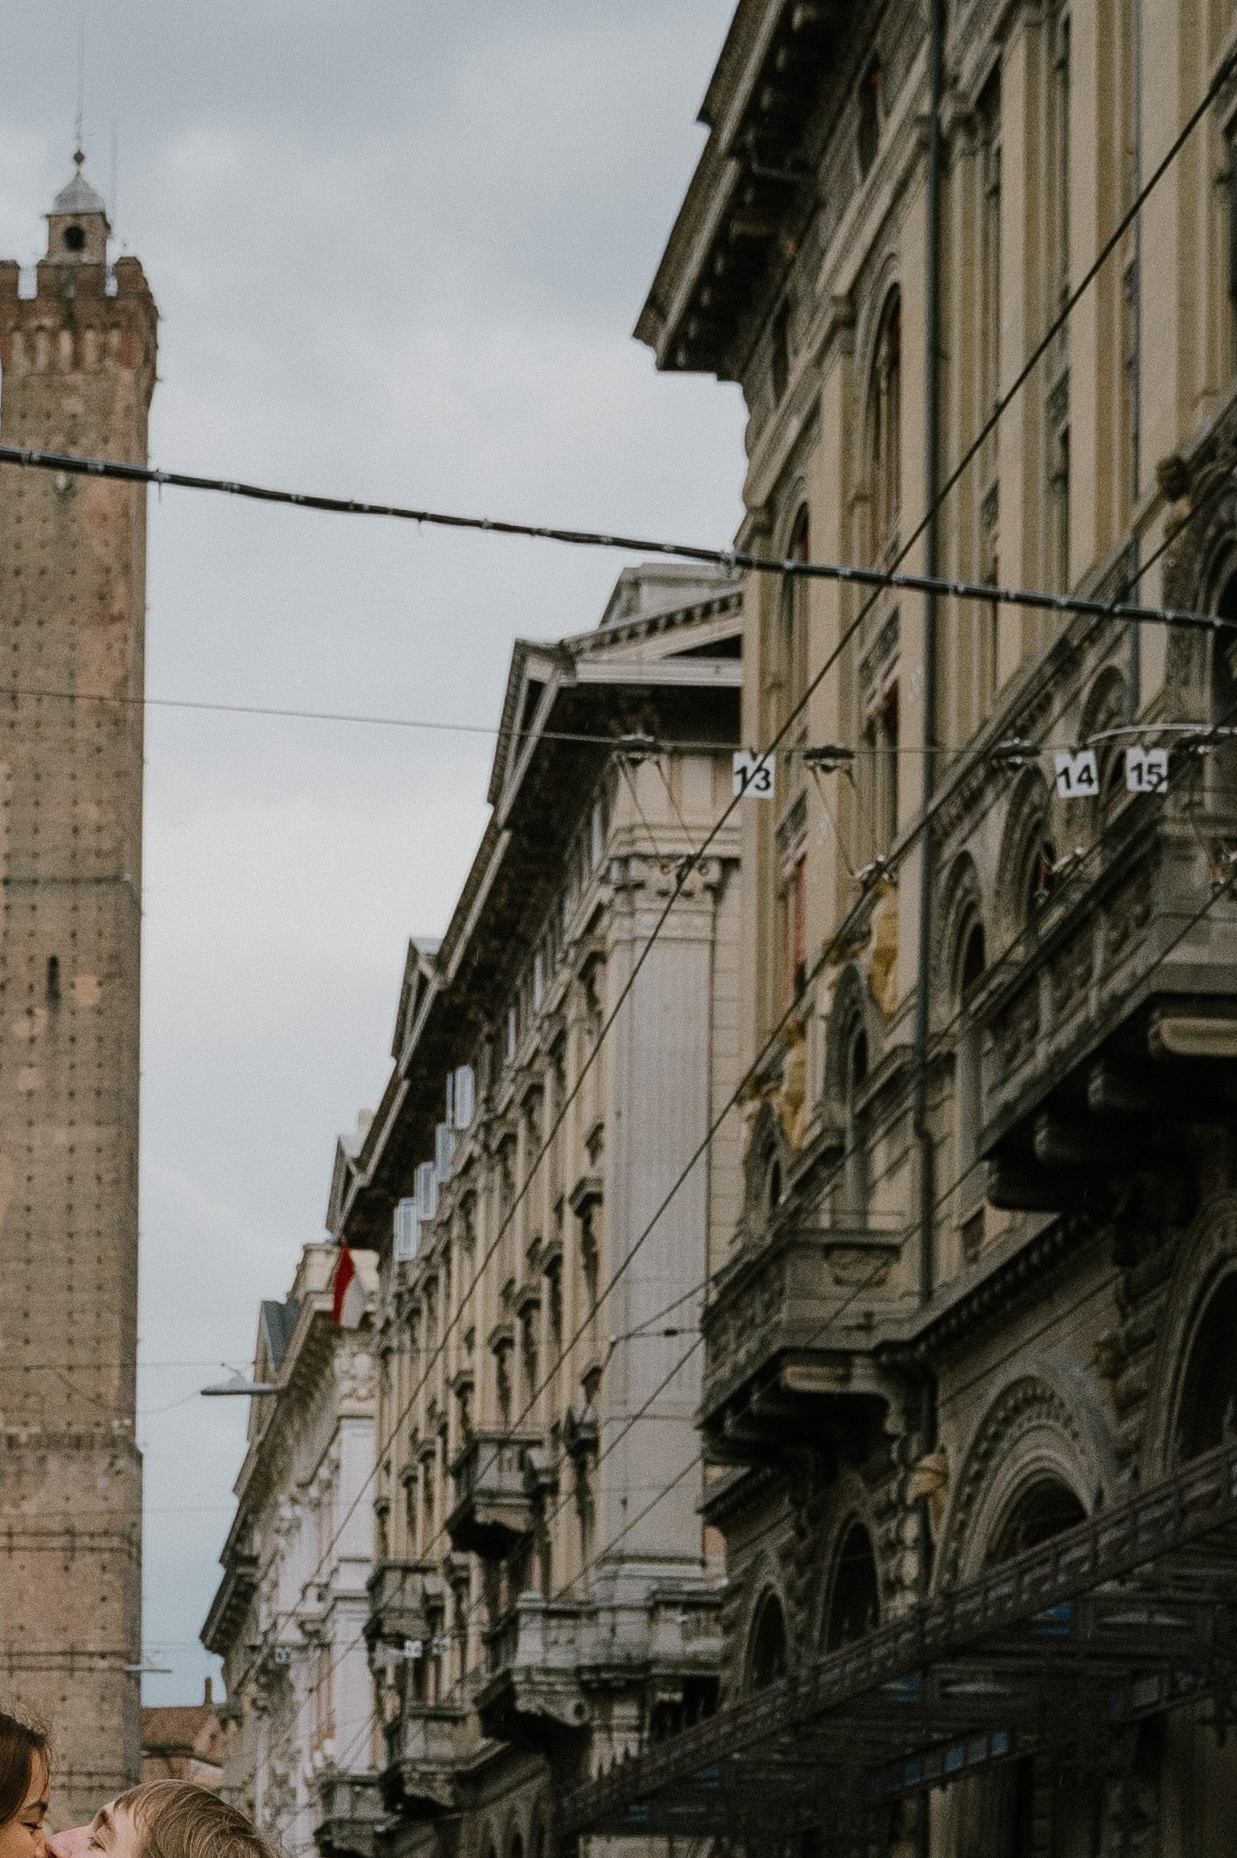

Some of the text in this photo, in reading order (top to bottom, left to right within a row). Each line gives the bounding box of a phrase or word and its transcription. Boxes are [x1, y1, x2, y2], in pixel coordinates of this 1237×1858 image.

[734, 765, 771, 792] 13
[1057, 763, 1095, 790] 14
[1130, 762, 1163, 787] 15
